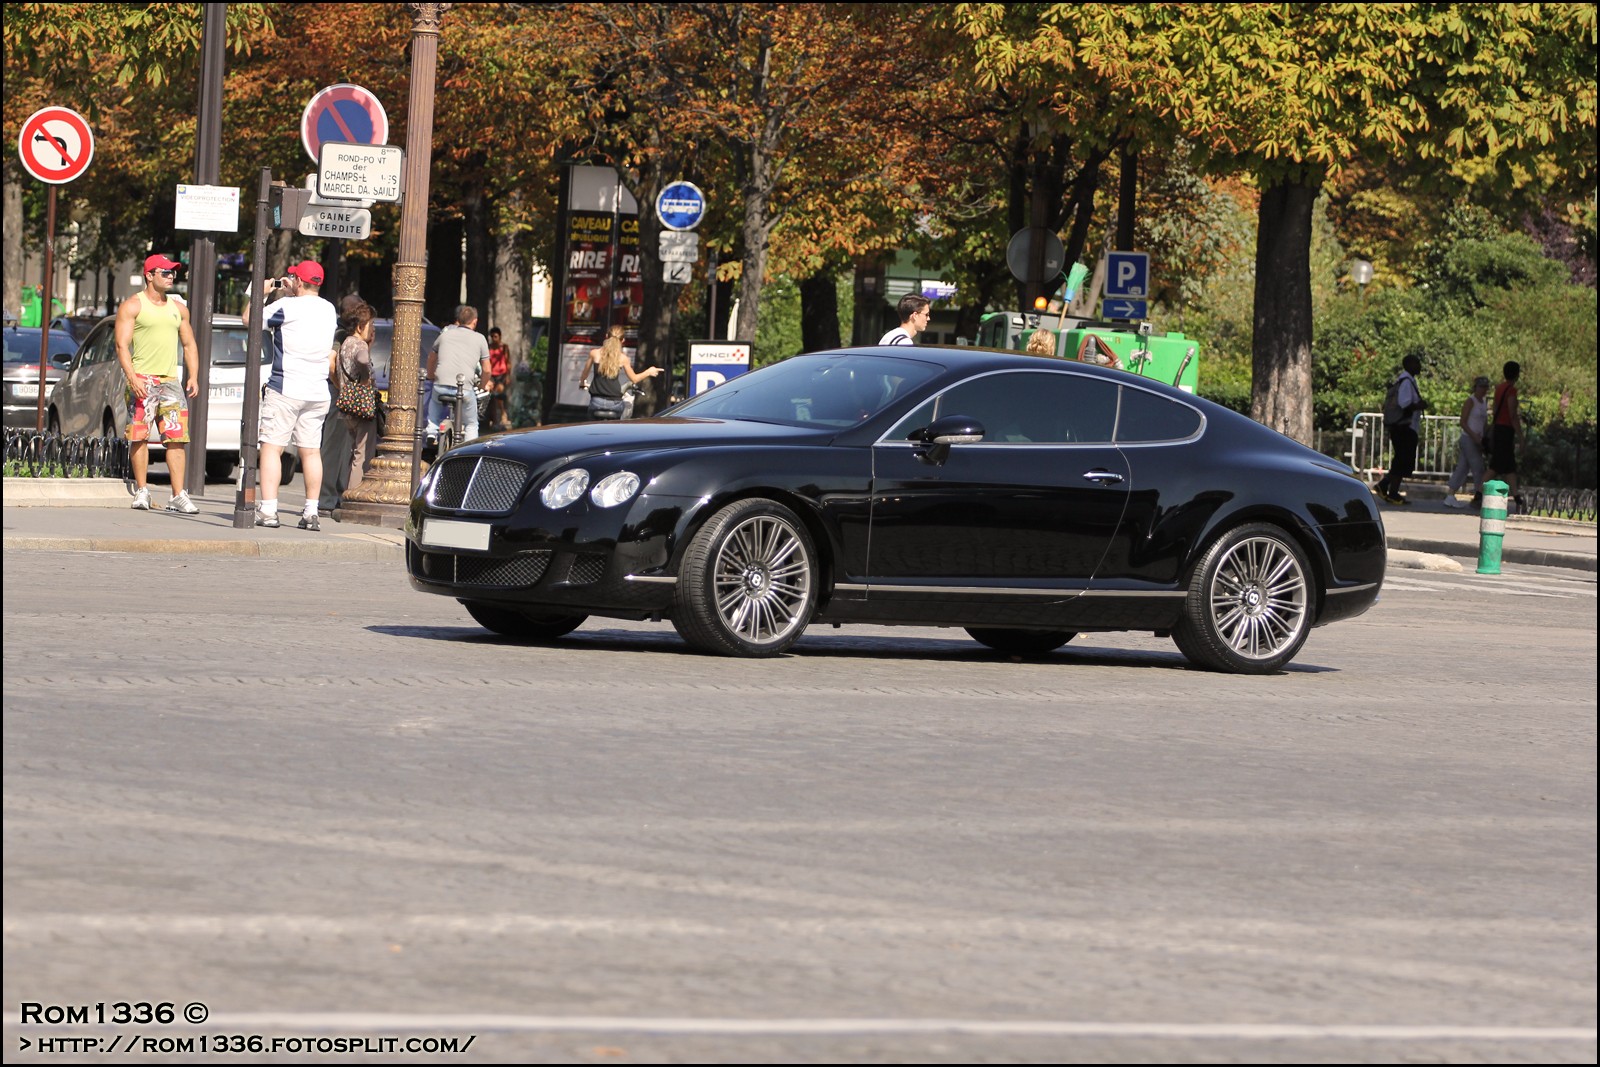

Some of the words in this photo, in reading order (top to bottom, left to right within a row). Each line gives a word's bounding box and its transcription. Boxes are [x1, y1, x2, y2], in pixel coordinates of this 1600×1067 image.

[338, 154, 386, 164] ROND-PONT
[323, 183, 355, 194] MARCEL
[358, 185, 396, 197] DASAULT
[320, 212, 351, 222] GAINE
[571, 216, 612, 231] CAVEAU
[307, 222, 362, 234] INTERDITE
[569, 250, 607, 269] RIRE
[620, 254, 641, 272] RI
[1117, 261, 1137, 288] P
